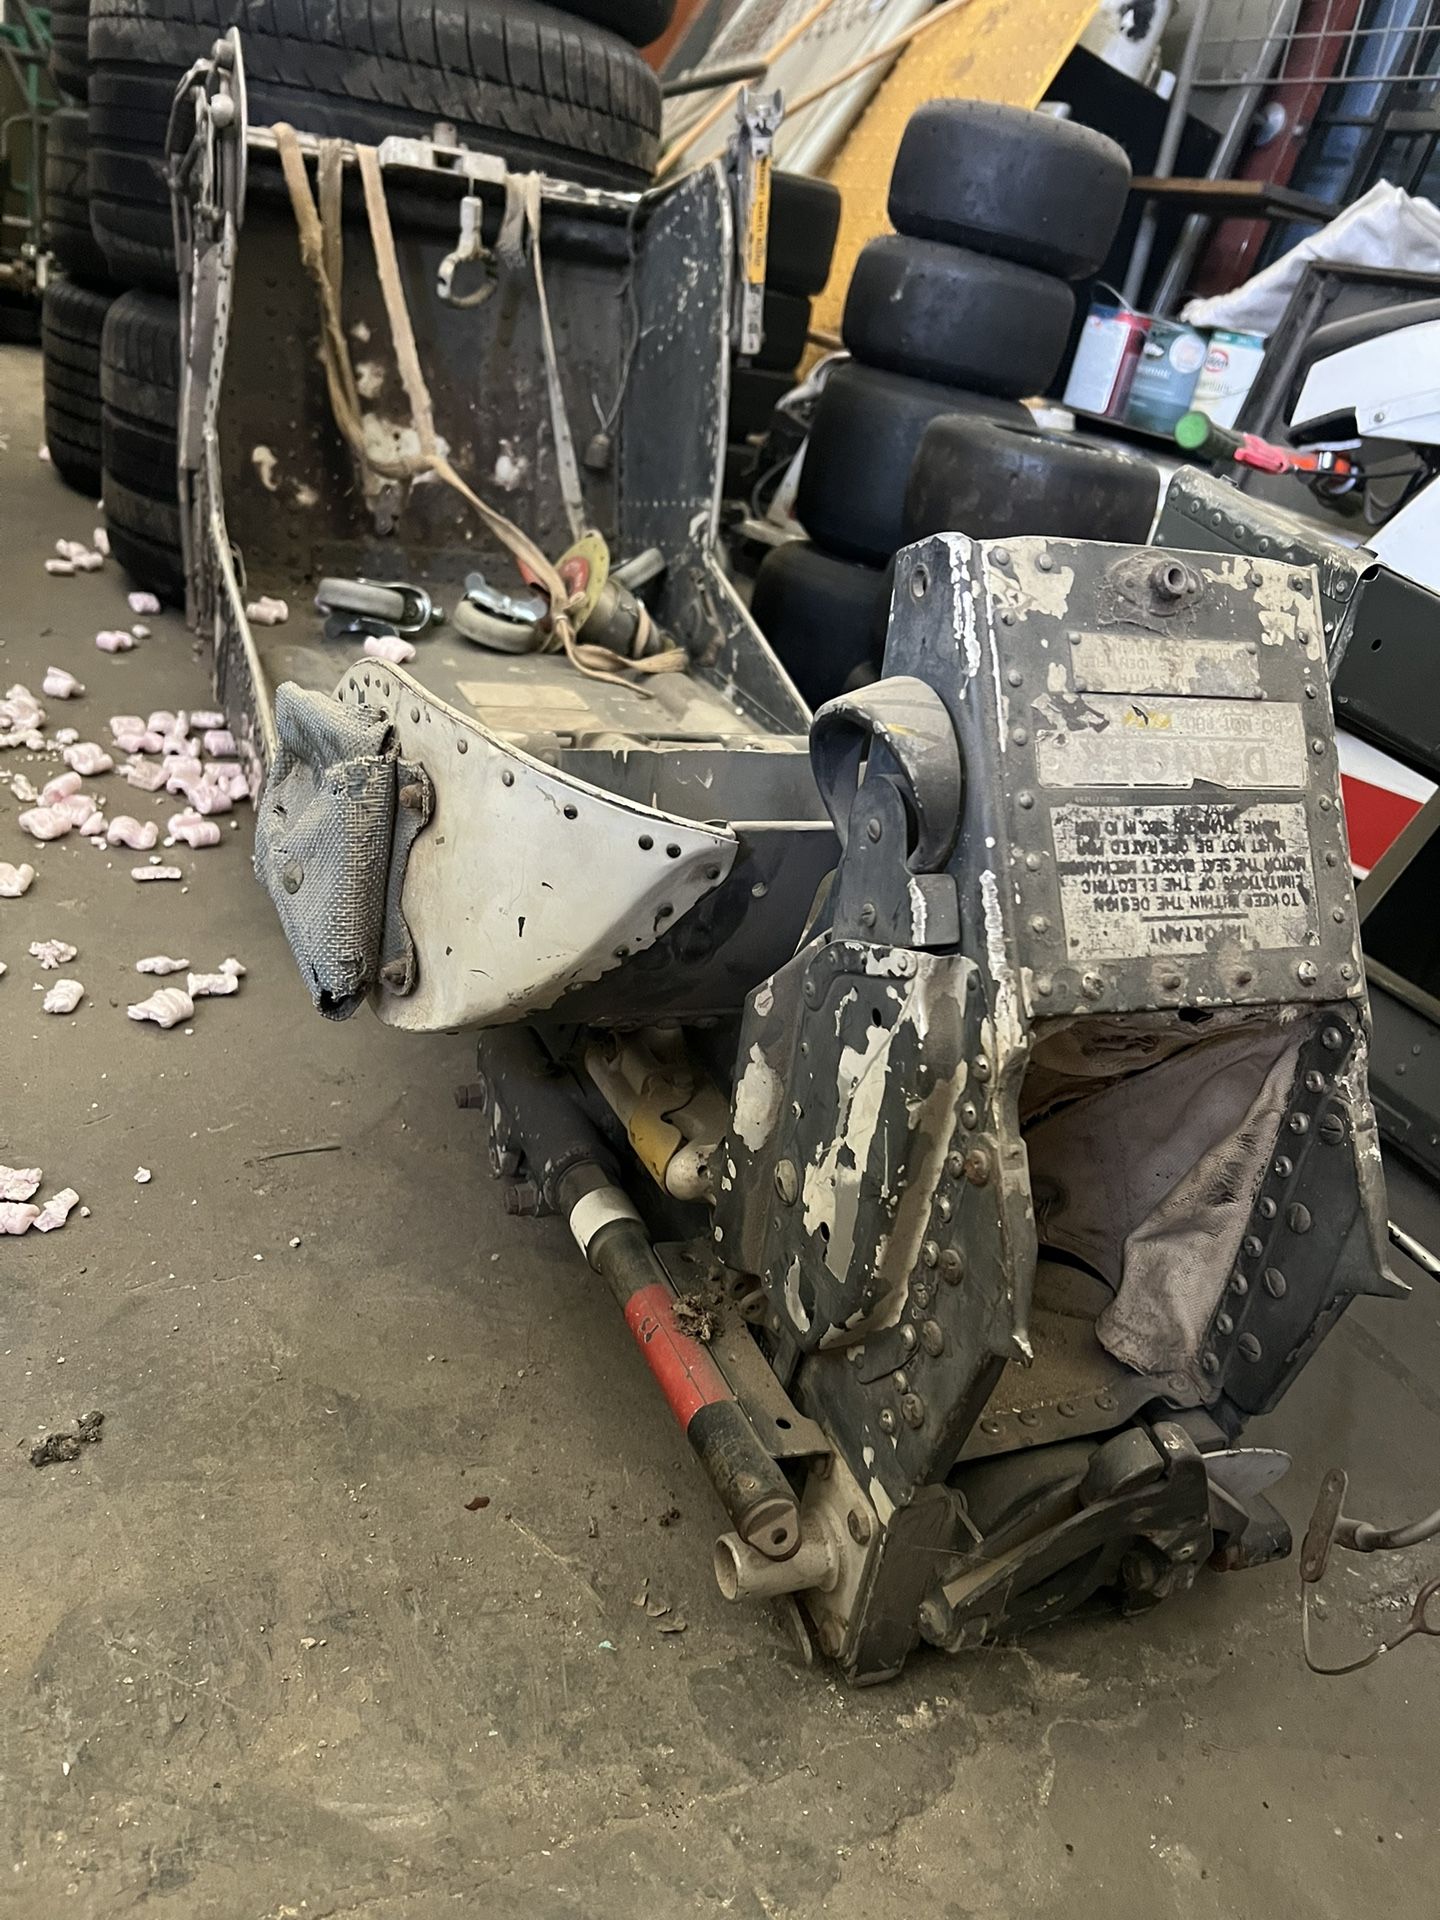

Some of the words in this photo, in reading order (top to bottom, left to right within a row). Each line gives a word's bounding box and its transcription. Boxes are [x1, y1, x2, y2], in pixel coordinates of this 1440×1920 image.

[1079, 656, 1150, 672] IDENFIED
[1224, 717, 1252, 733] NOT
[1262, 718, 1283, 735] DO
[1080, 741, 1268, 782] DANGER
[1243, 820, 1280, 834] MRE
[1111, 839, 1188, 854] OPERATED
[1196, 840, 1214, 853] BE
[1220, 839, 1246, 853] NOT
[1251, 839, 1286, 853] MUST
[1057, 860, 1137, 876] MECHAN
[1142, 859, 1195, 874] BUCKET
[1200, 858, 1231, 873] SEAT
[1234, 858, 1262, 873] THE
[1264, 857, 1305, 873] MOTOR
[1081, 878, 1158, 894] ELECTRIC
[1162, 877, 1191, 892] THE
[1199, 877, 1215, 891] OF
[1223, 875, 1303, 891] LIMITATIONS
[1094, 897, 1150, 912] DESIGN
[1156, 896, 1184, 910] THE
[1190, 894, 1239, 909] WITHIN
[1244, 893, 1278, 907] KEEP
[1282, 893, 1299, 907] TO
[1149, 924, 1248, 944] IMORTANT
